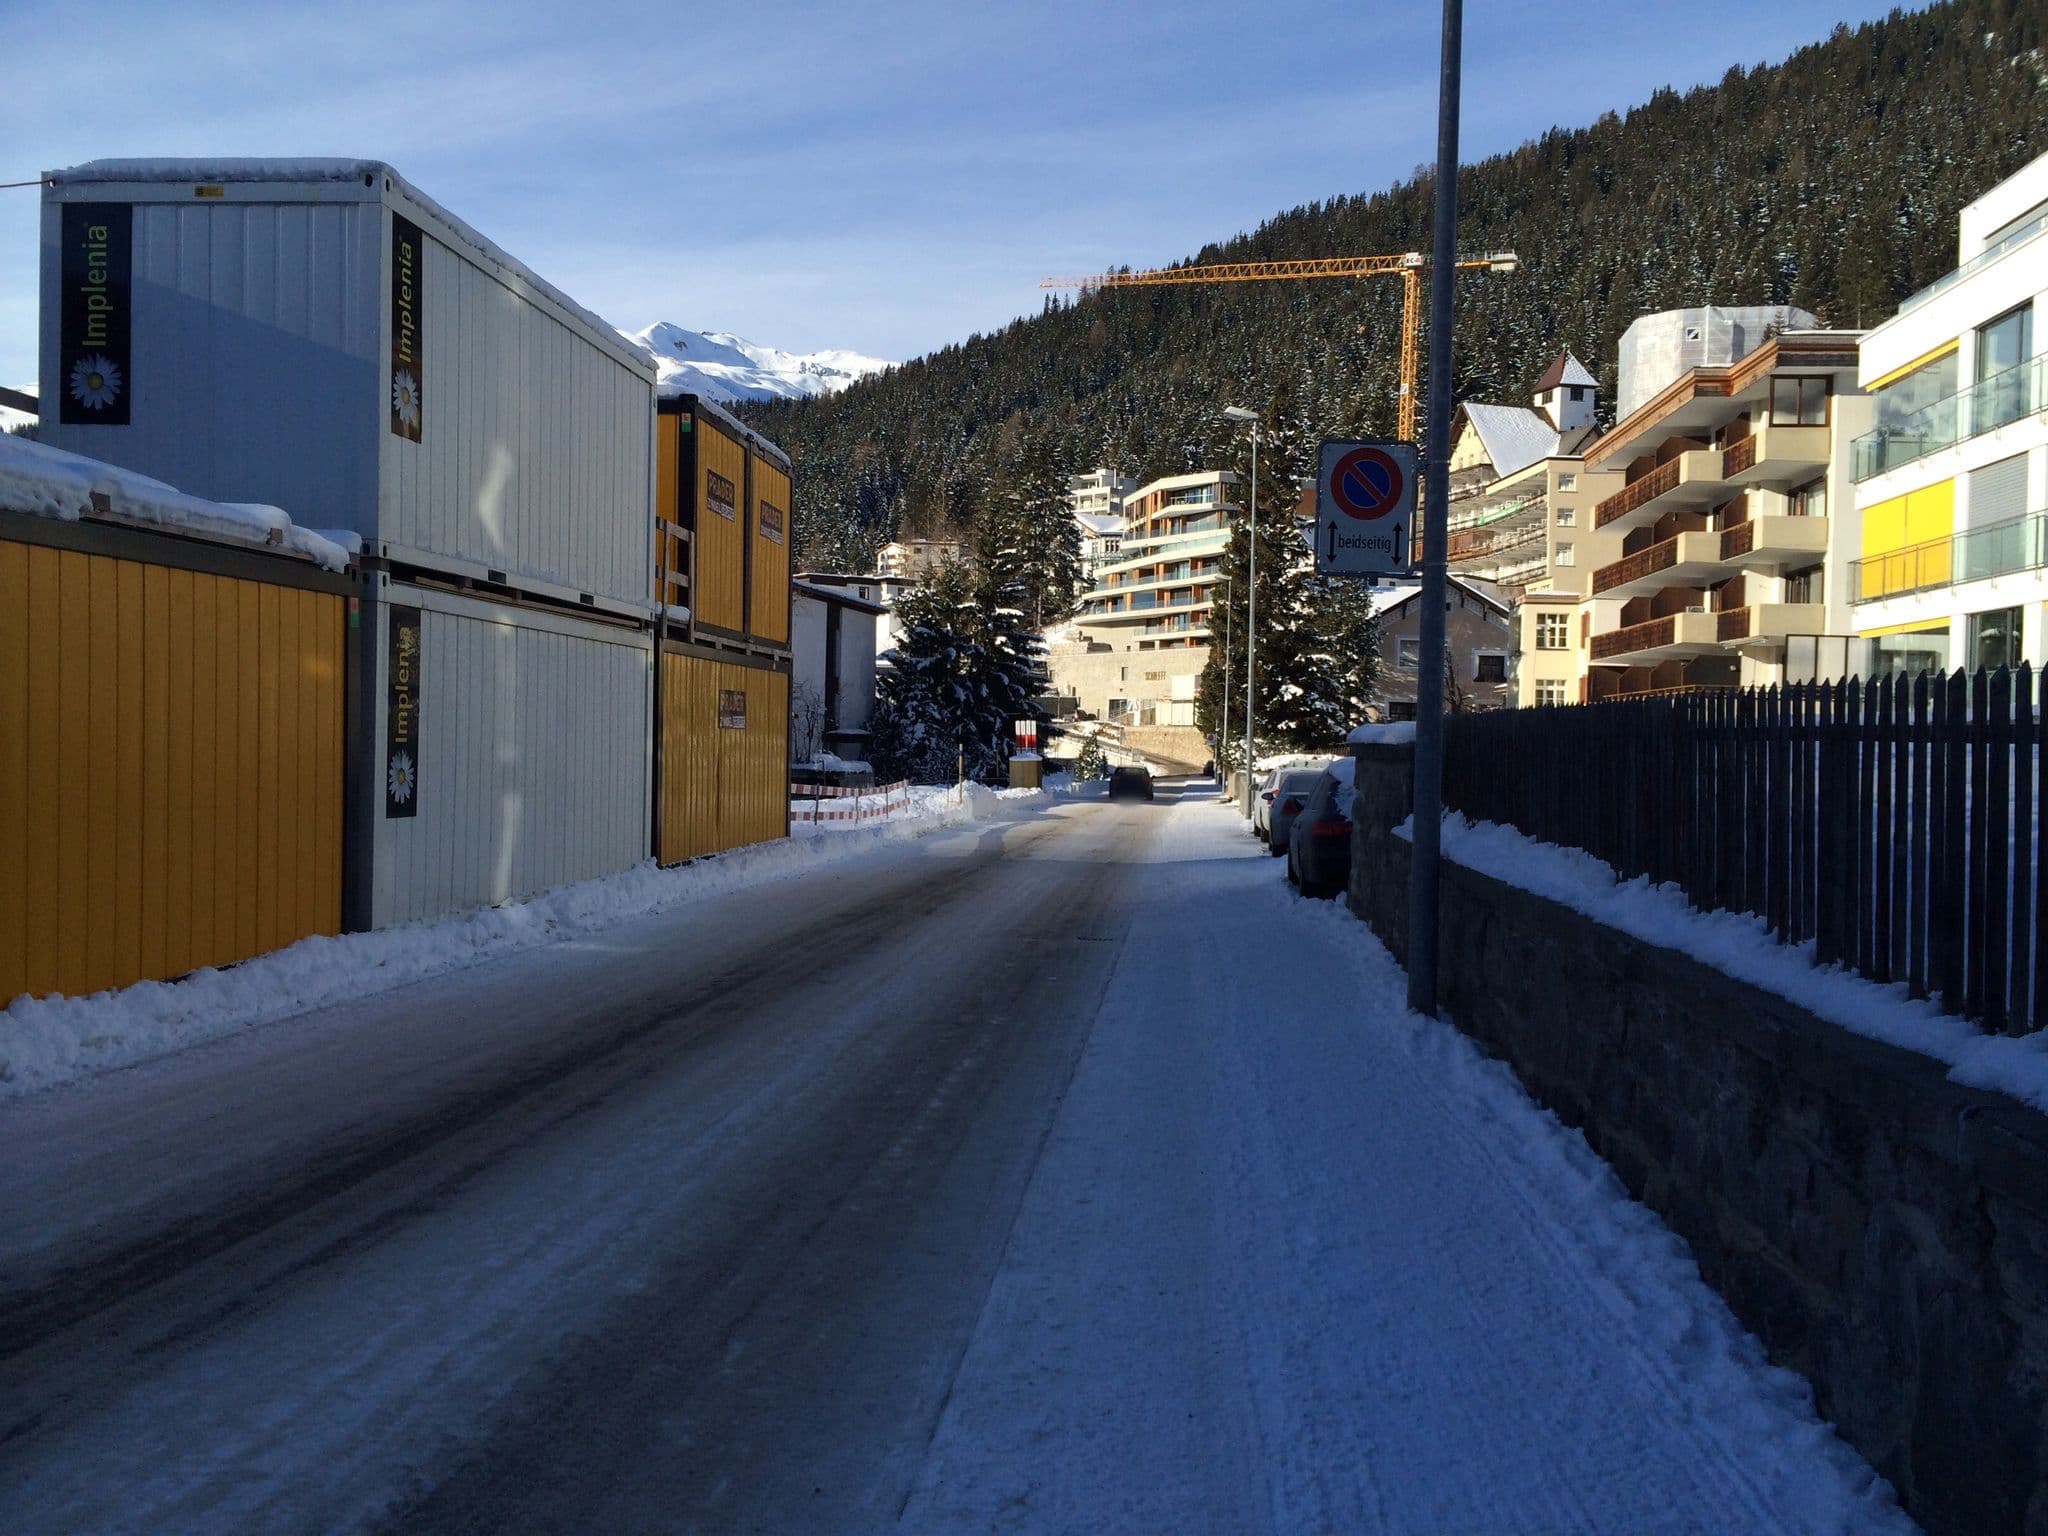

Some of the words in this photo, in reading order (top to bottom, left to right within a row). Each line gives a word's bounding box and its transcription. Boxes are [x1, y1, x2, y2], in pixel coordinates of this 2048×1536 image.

[81, 225, 113, 346] Implenia
[398, 242, 415, 363] Implenia
[1338, 534, 1391, 553] beidseitig
[395, 627, 413, 743] Implenia
